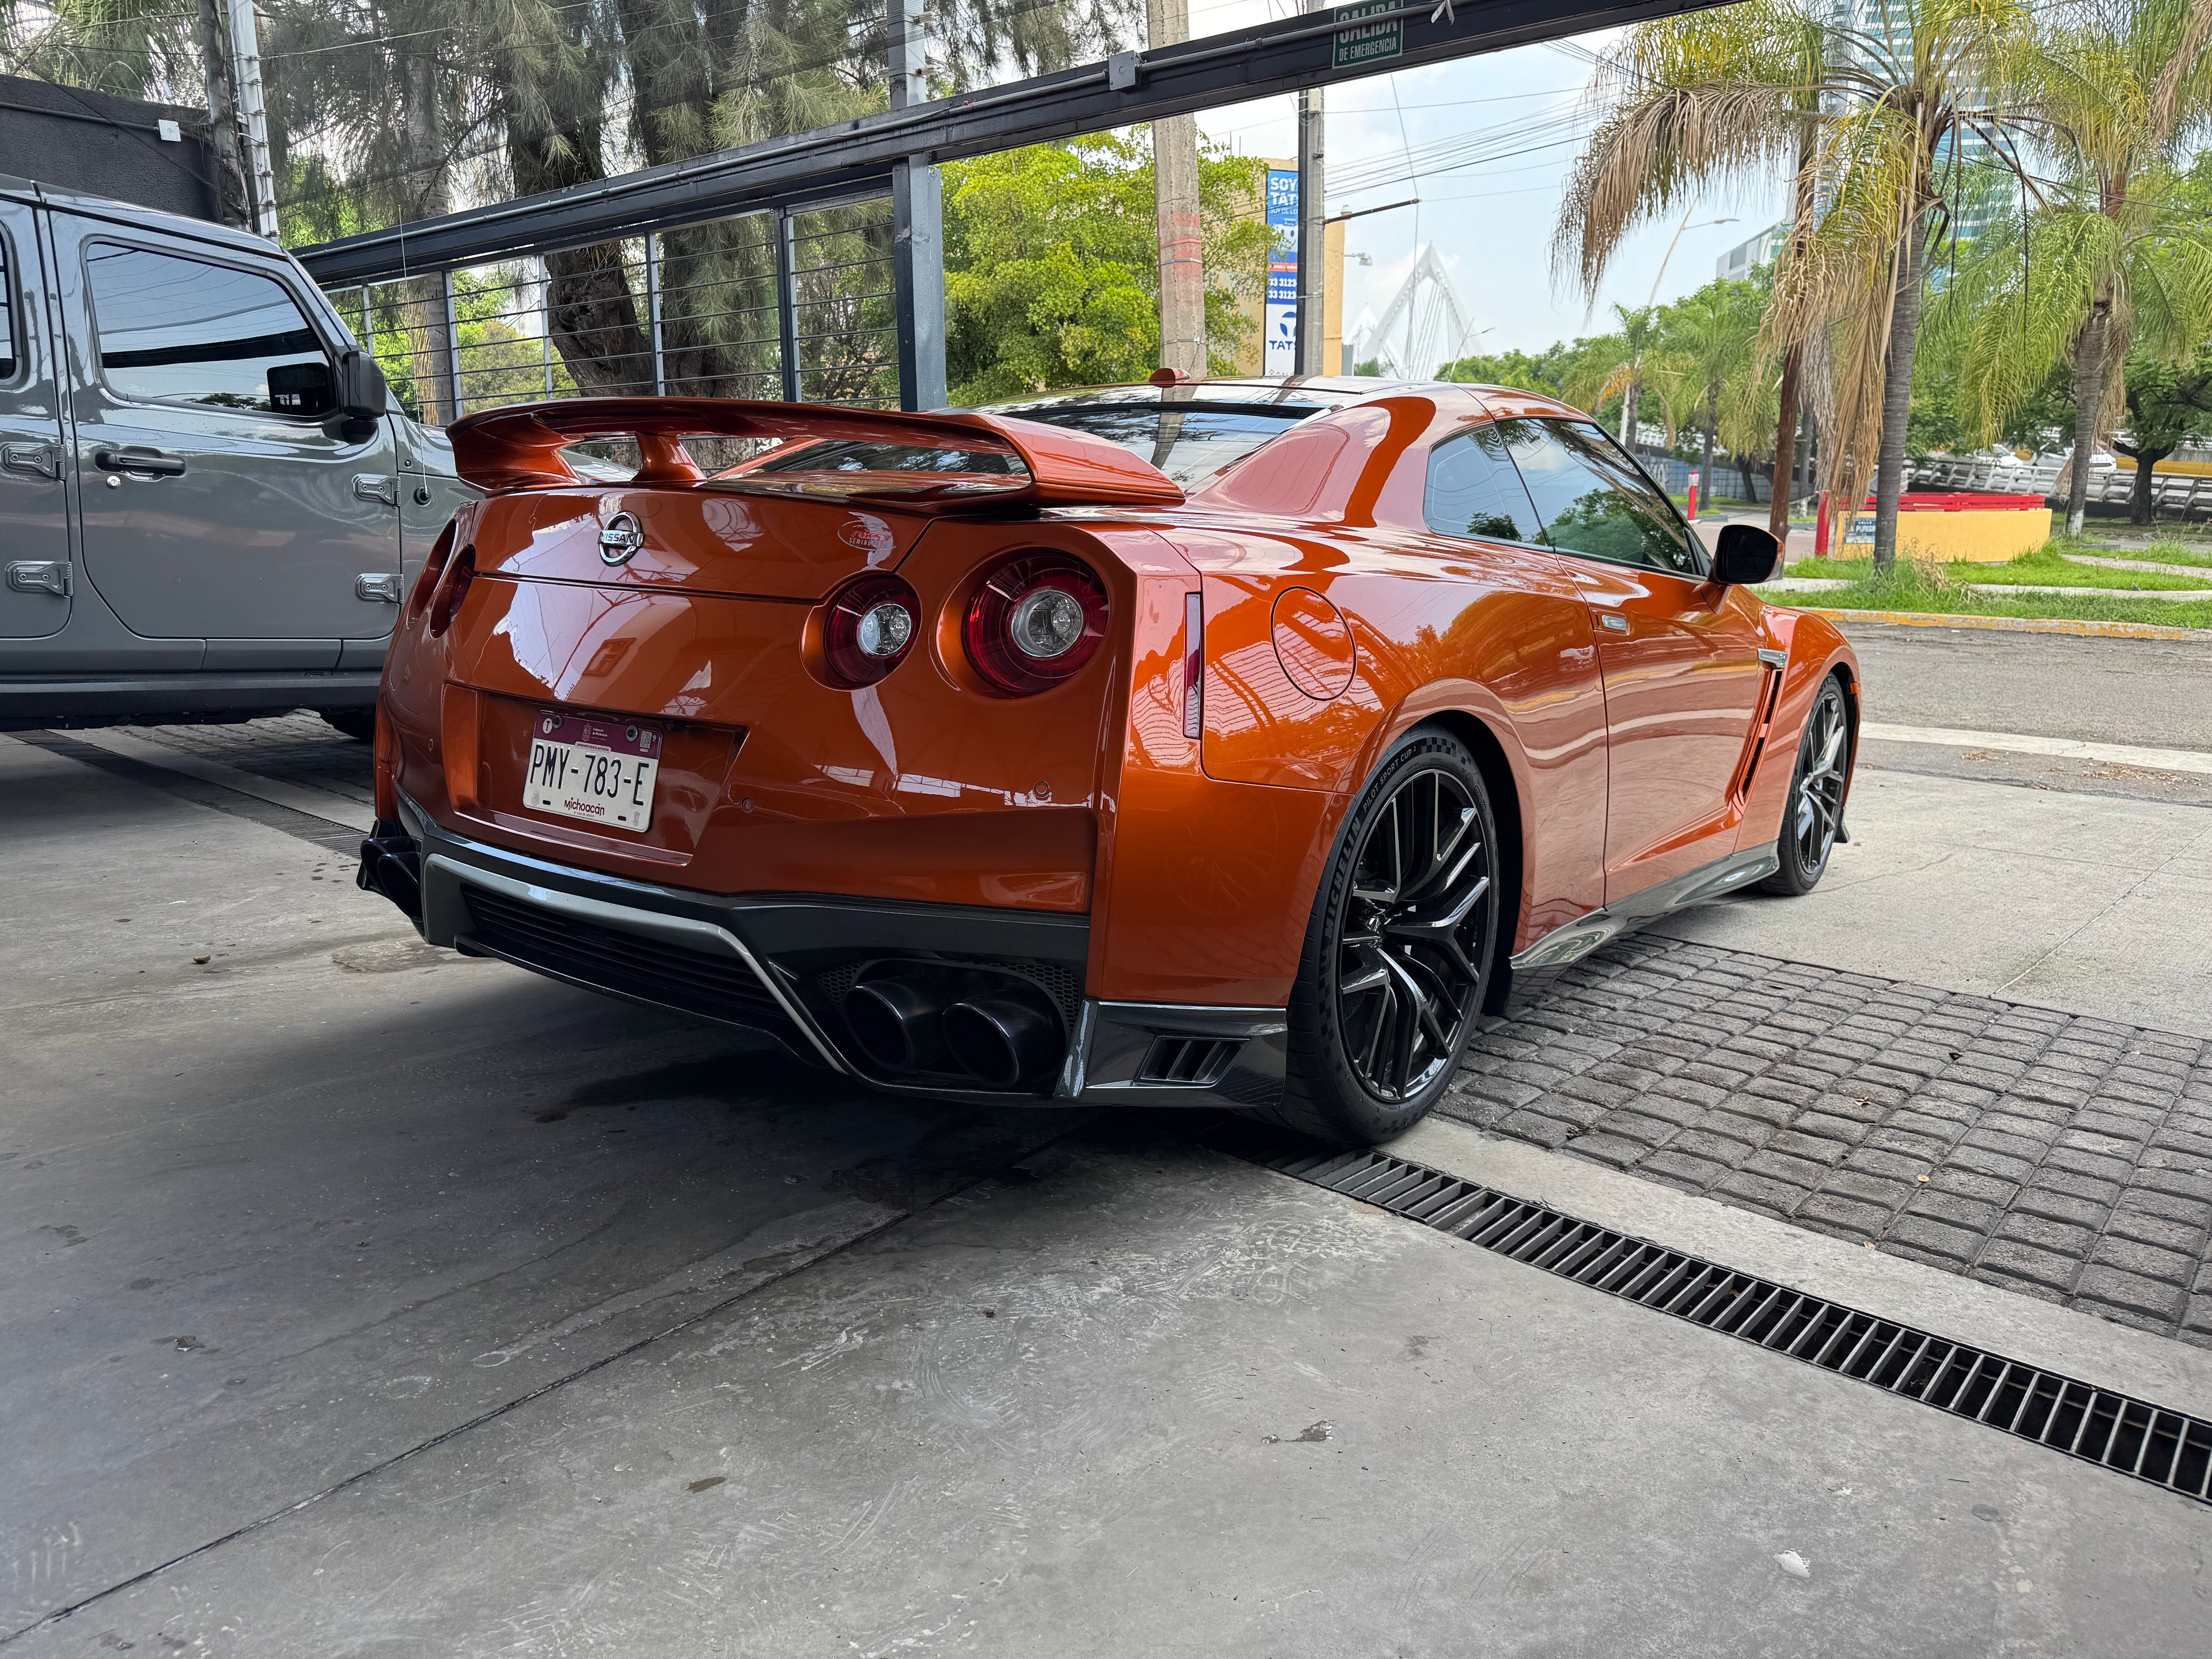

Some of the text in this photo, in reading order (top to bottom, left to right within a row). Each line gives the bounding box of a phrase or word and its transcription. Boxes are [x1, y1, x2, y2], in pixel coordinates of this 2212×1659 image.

[1339, 1, 1397, 43] SALIDA
[1339, 37, 1397, 62] DE EMERGENCIA
[1270, 177, 1298, 192] SOY
[1270, 192, 1298, 206] TAT
[1268, 278, 1278, 287] 33
[1268, 290, 1278, 299] 33
[1269, 340, 1295, 350] TAT
[598, 531, 635, 544] NISSAN
[546, 721, 550, 732] T
[530, 744, 649, 806] PMY-783-E
[1363, 783, 1378, 813] PILOT
[1380, 758, 1399, 785] SPORT
[1400, 749, 1412, 762] CUP
[564, 797, 605, 816] Michoacán
[1324, 817, 1361, 938] MICHELIN
